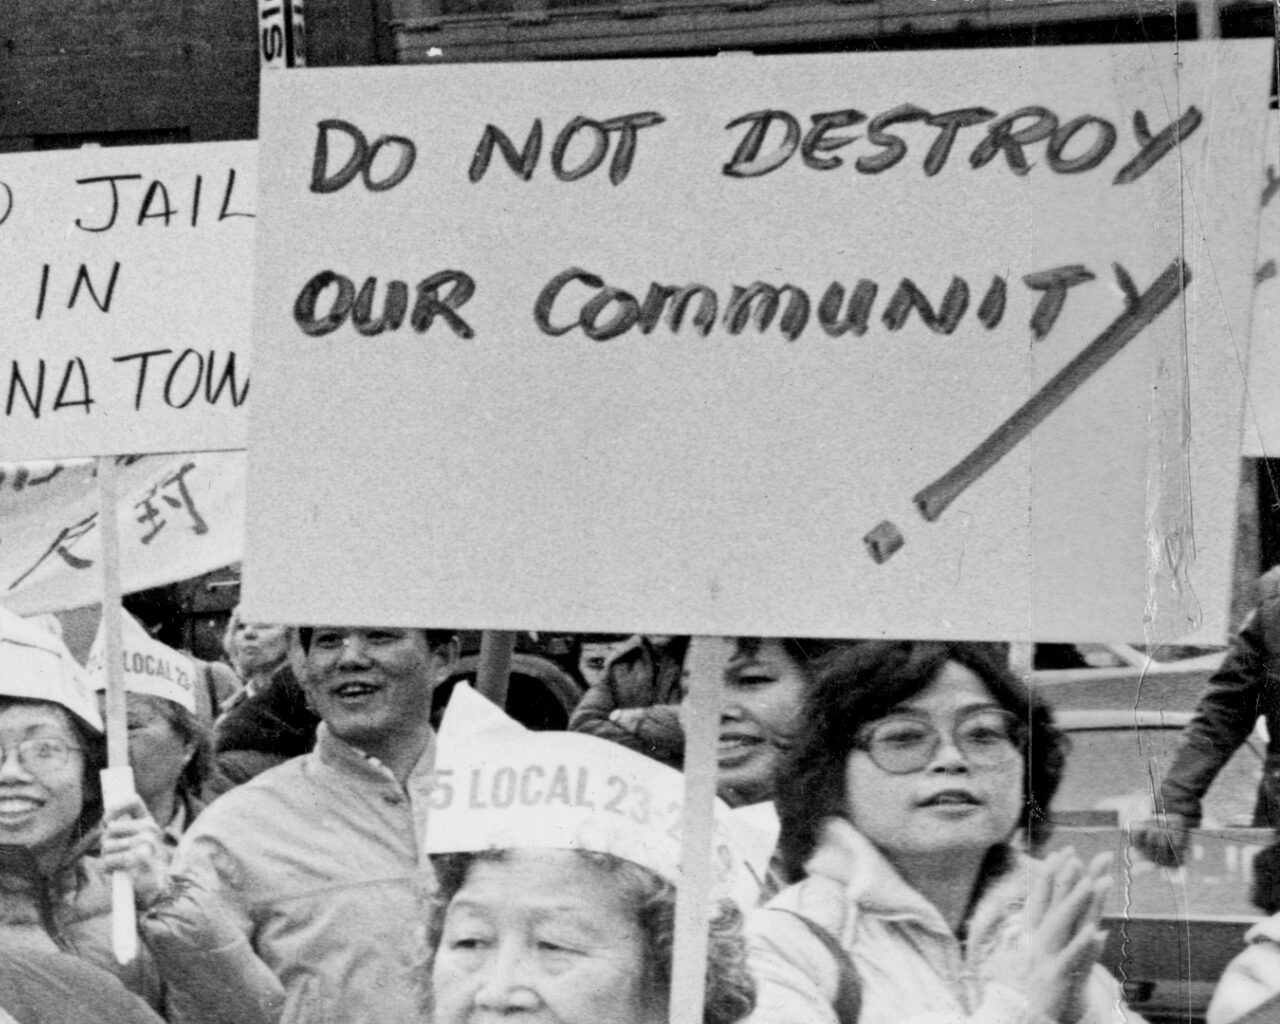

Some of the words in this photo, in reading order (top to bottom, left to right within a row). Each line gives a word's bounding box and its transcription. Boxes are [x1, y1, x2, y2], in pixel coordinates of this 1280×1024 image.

[308, 117, 418, 194] DO
[468, 110, 665, 187] NOT
[721, 104, 1204, 187] DESTROY
[74, 168, 256, 233] JAIL
[35, 261, 121, 320] IN
[292, 268, 476, 340] OUR
[122, 650, 174, 682] LOCAL
[468, 764, 596, 810] LOCAL
